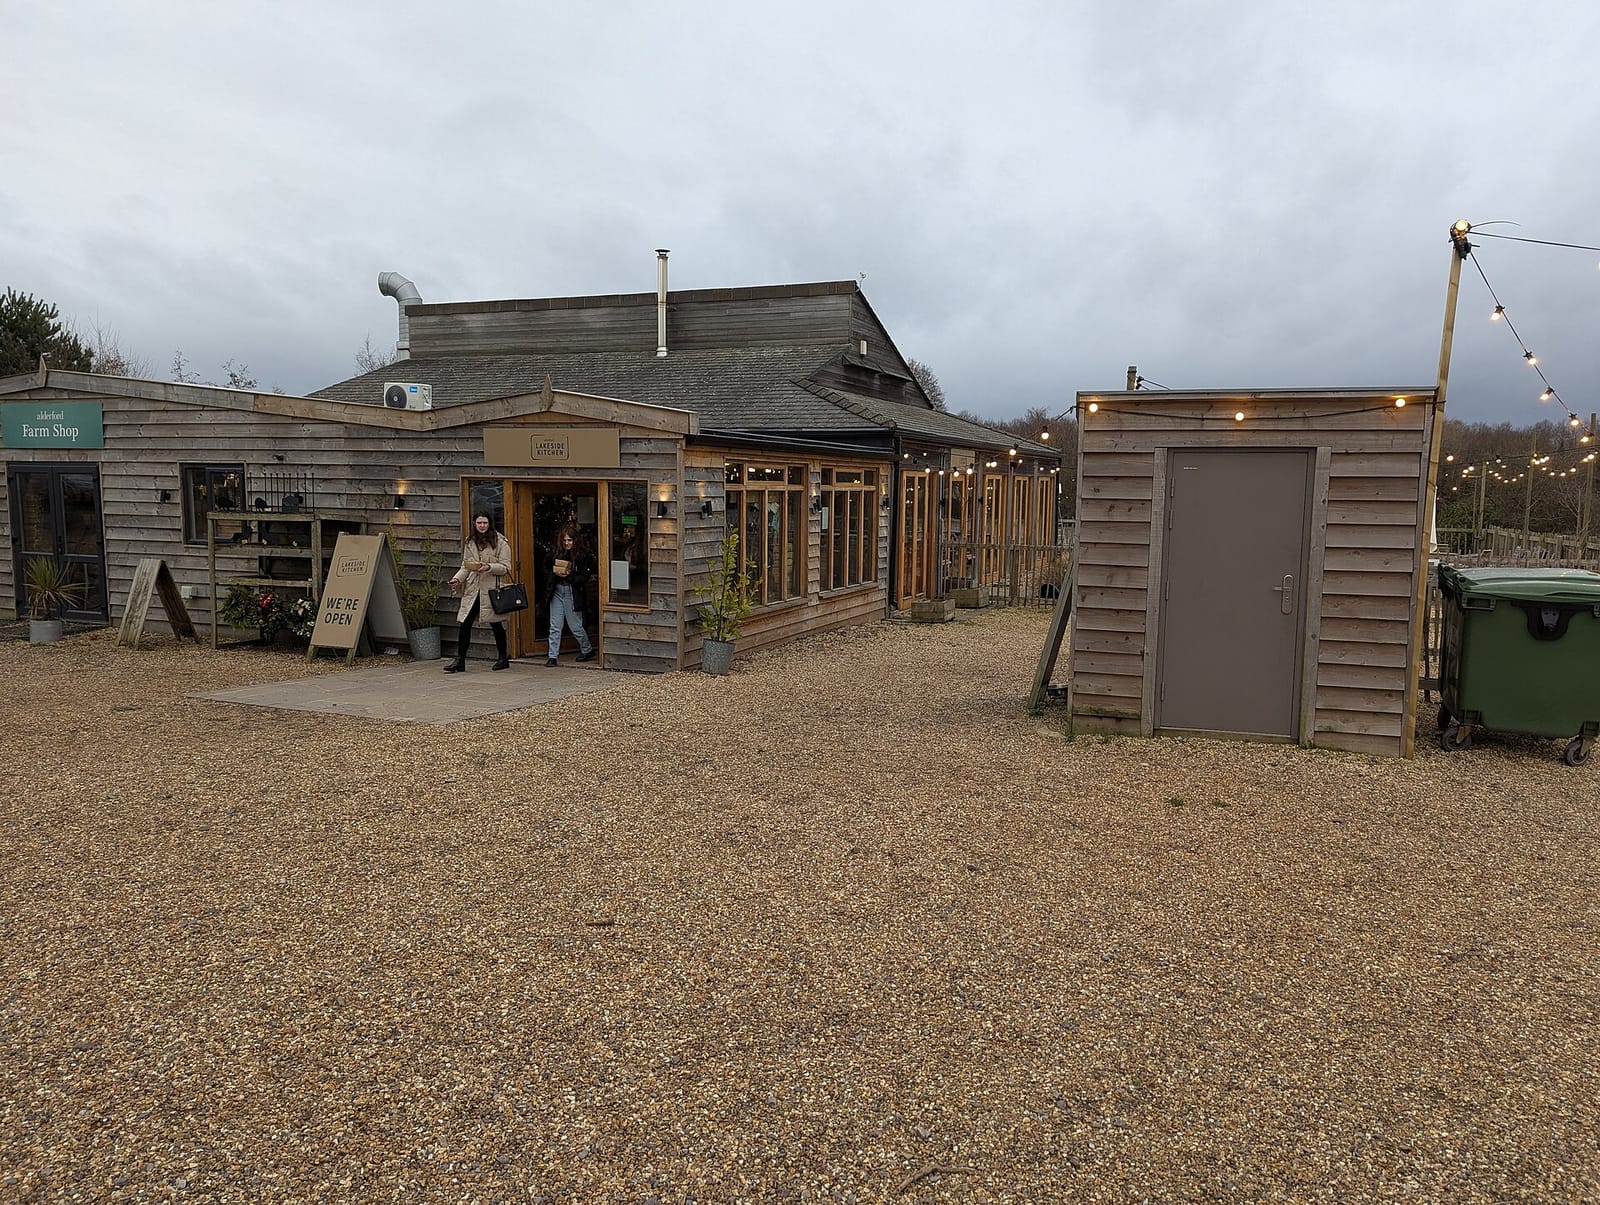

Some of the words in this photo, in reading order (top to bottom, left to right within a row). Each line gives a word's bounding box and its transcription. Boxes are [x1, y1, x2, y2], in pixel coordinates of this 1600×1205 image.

[36, 411, 64, 420] alderford
[22, 424, 50, 437] Farm
[53, 424, 79, 442] Shop
[326, 597, 359, 610] WE'RE
[324, 612, 353, 626] OPEN
